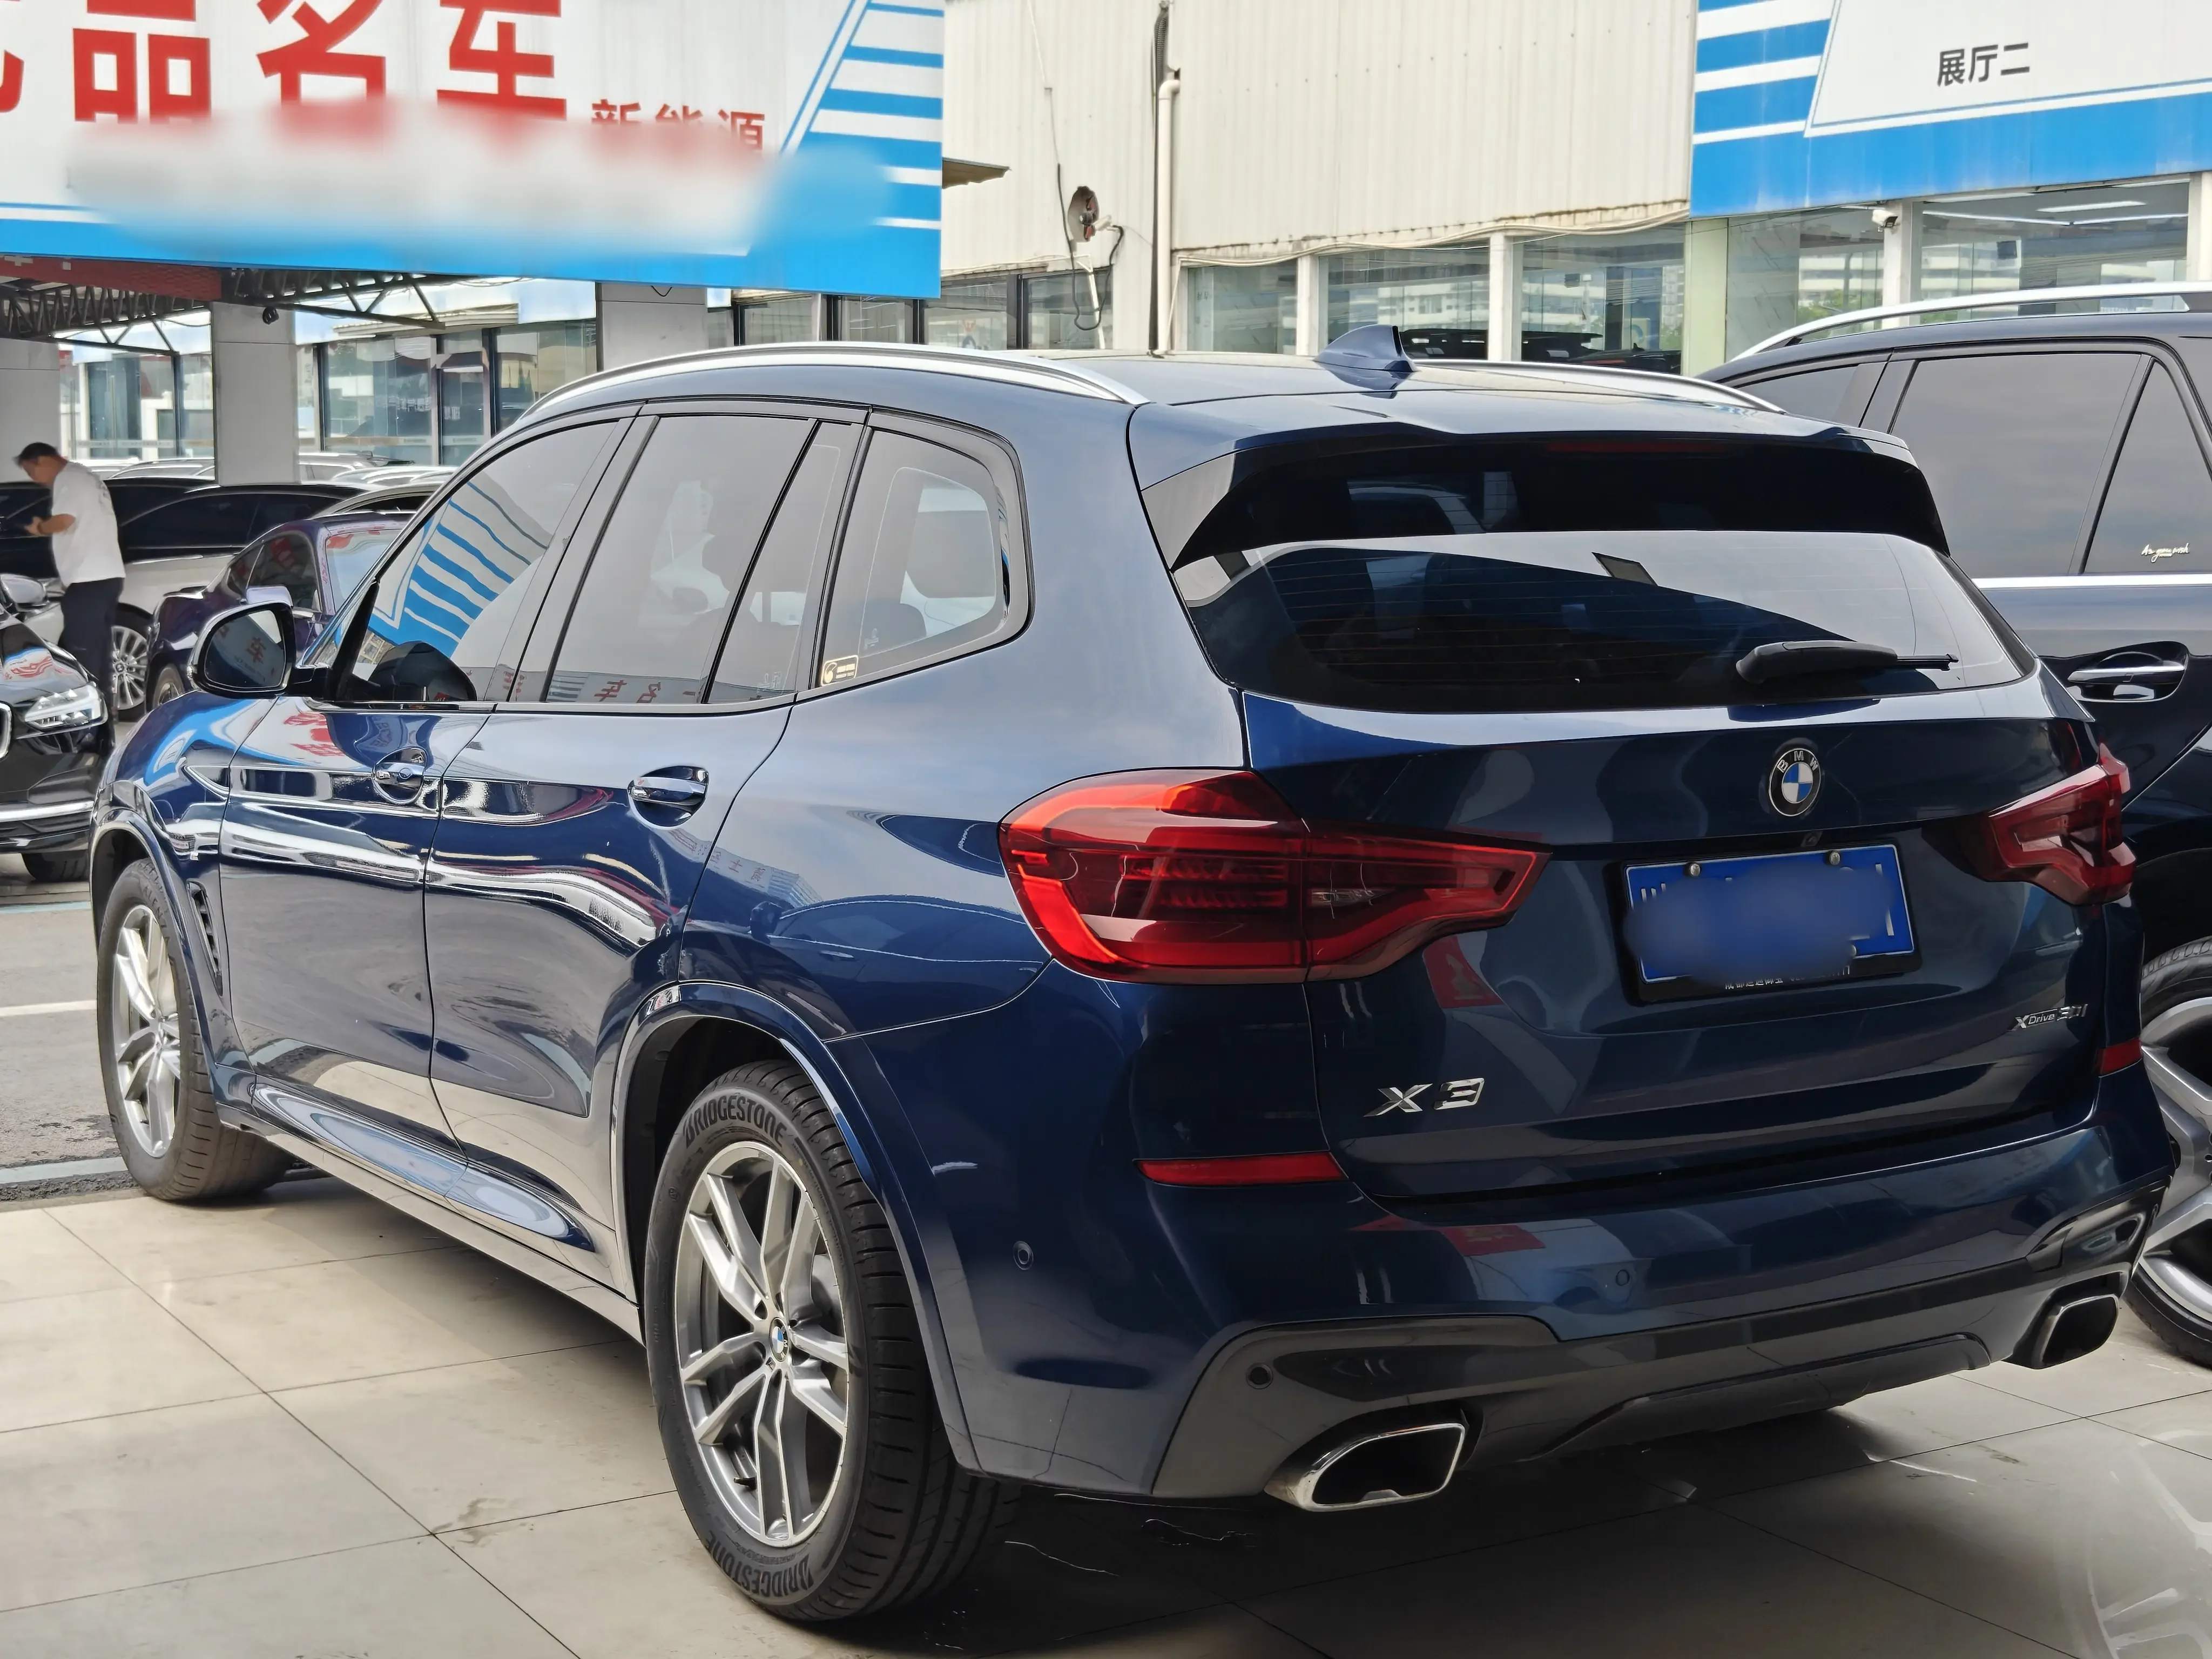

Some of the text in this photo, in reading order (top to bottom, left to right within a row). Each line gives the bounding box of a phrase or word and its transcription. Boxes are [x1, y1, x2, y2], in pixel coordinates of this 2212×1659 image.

[0, 0, 567, 124] 品名车
[1937, 42, 2030, 87] 展厅二
[1777, 750, 1818, 773] BMW
[683, 1095, 788, 1149] BRIDGESTONE
[706, 1529, 814, 1597] BRIDGESTONE
